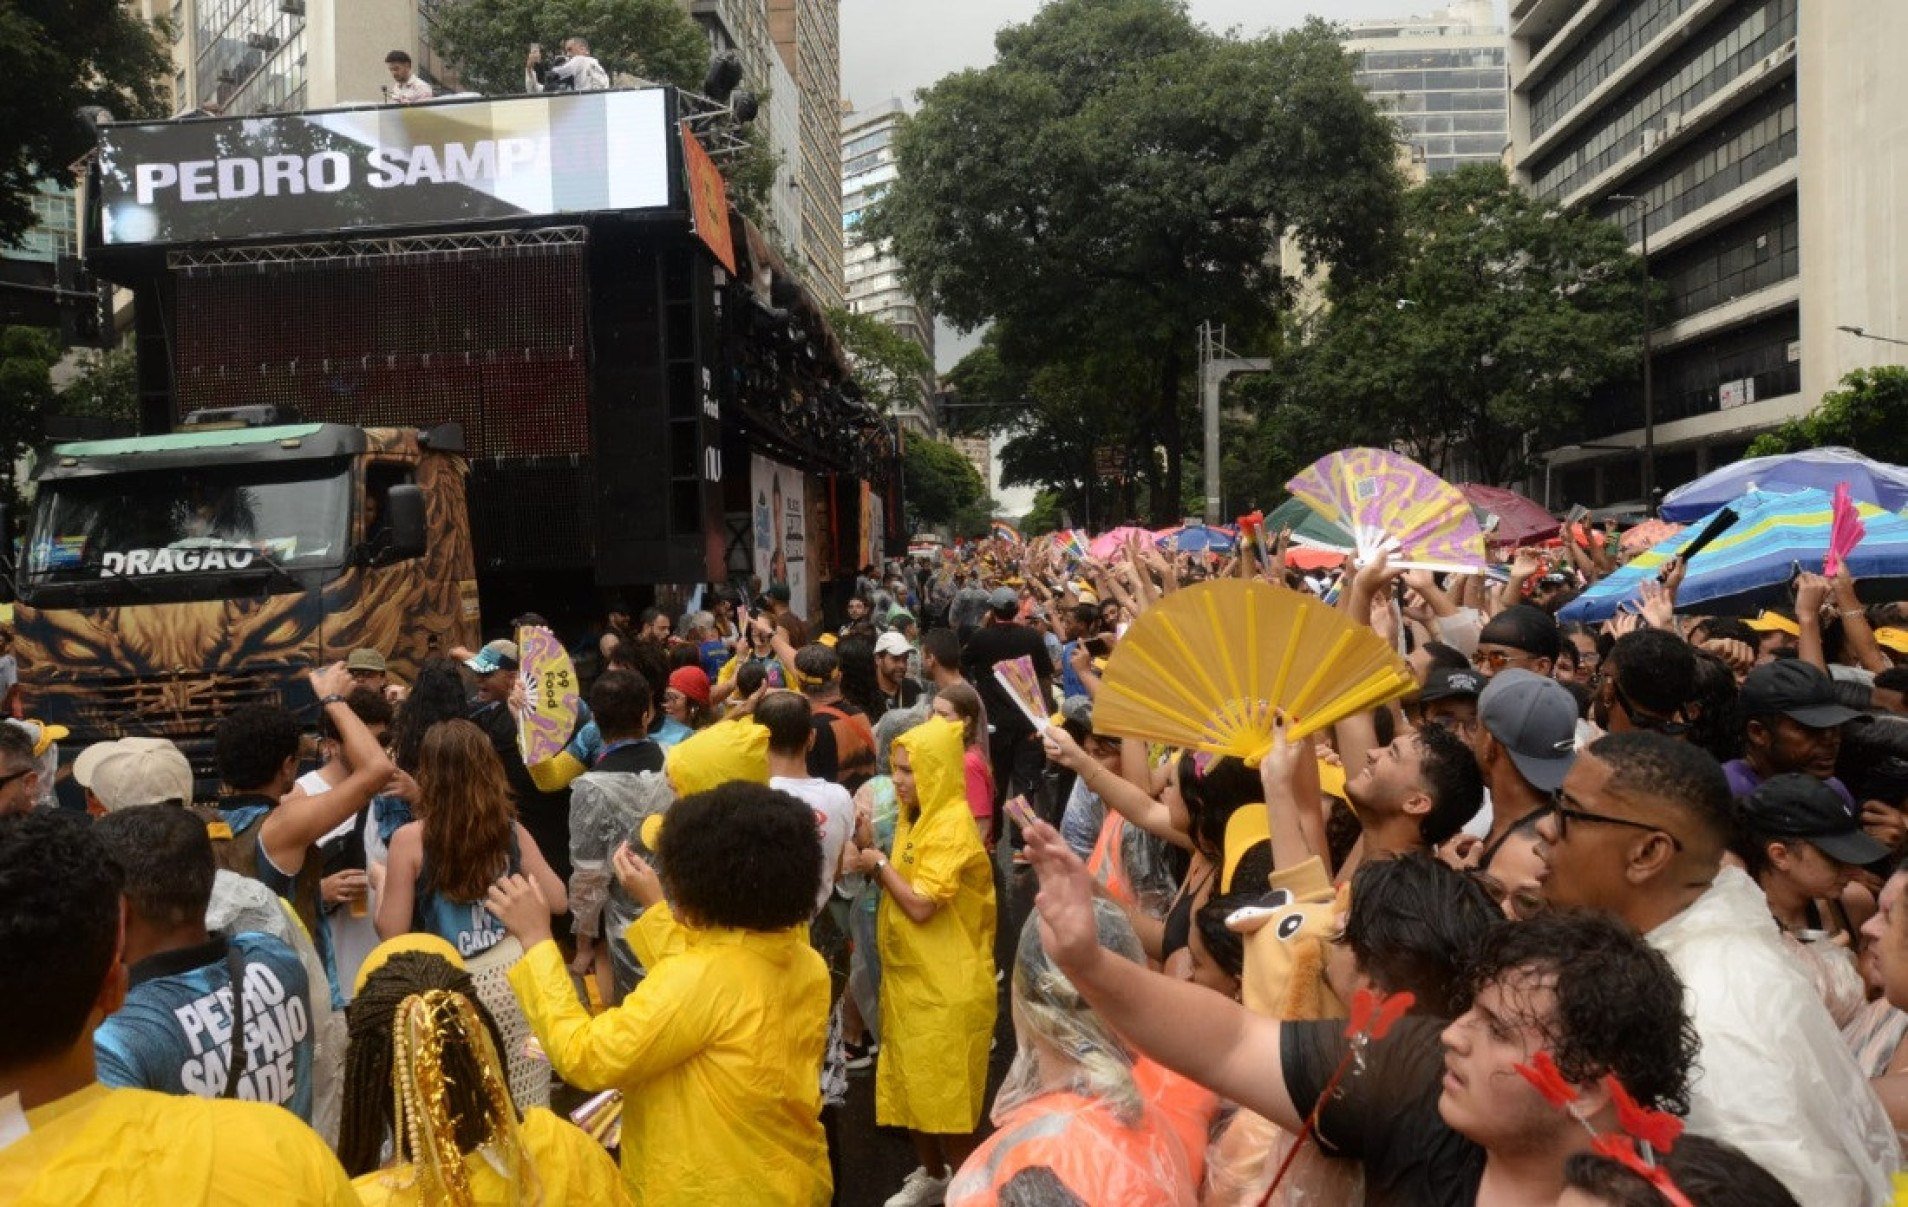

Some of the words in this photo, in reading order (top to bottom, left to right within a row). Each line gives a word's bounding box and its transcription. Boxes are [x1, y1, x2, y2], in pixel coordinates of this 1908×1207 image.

[135, 150, 351, 205] PEDRO
[545, 671, 558, 709] Food
[557, 670, 569, 688] 99
